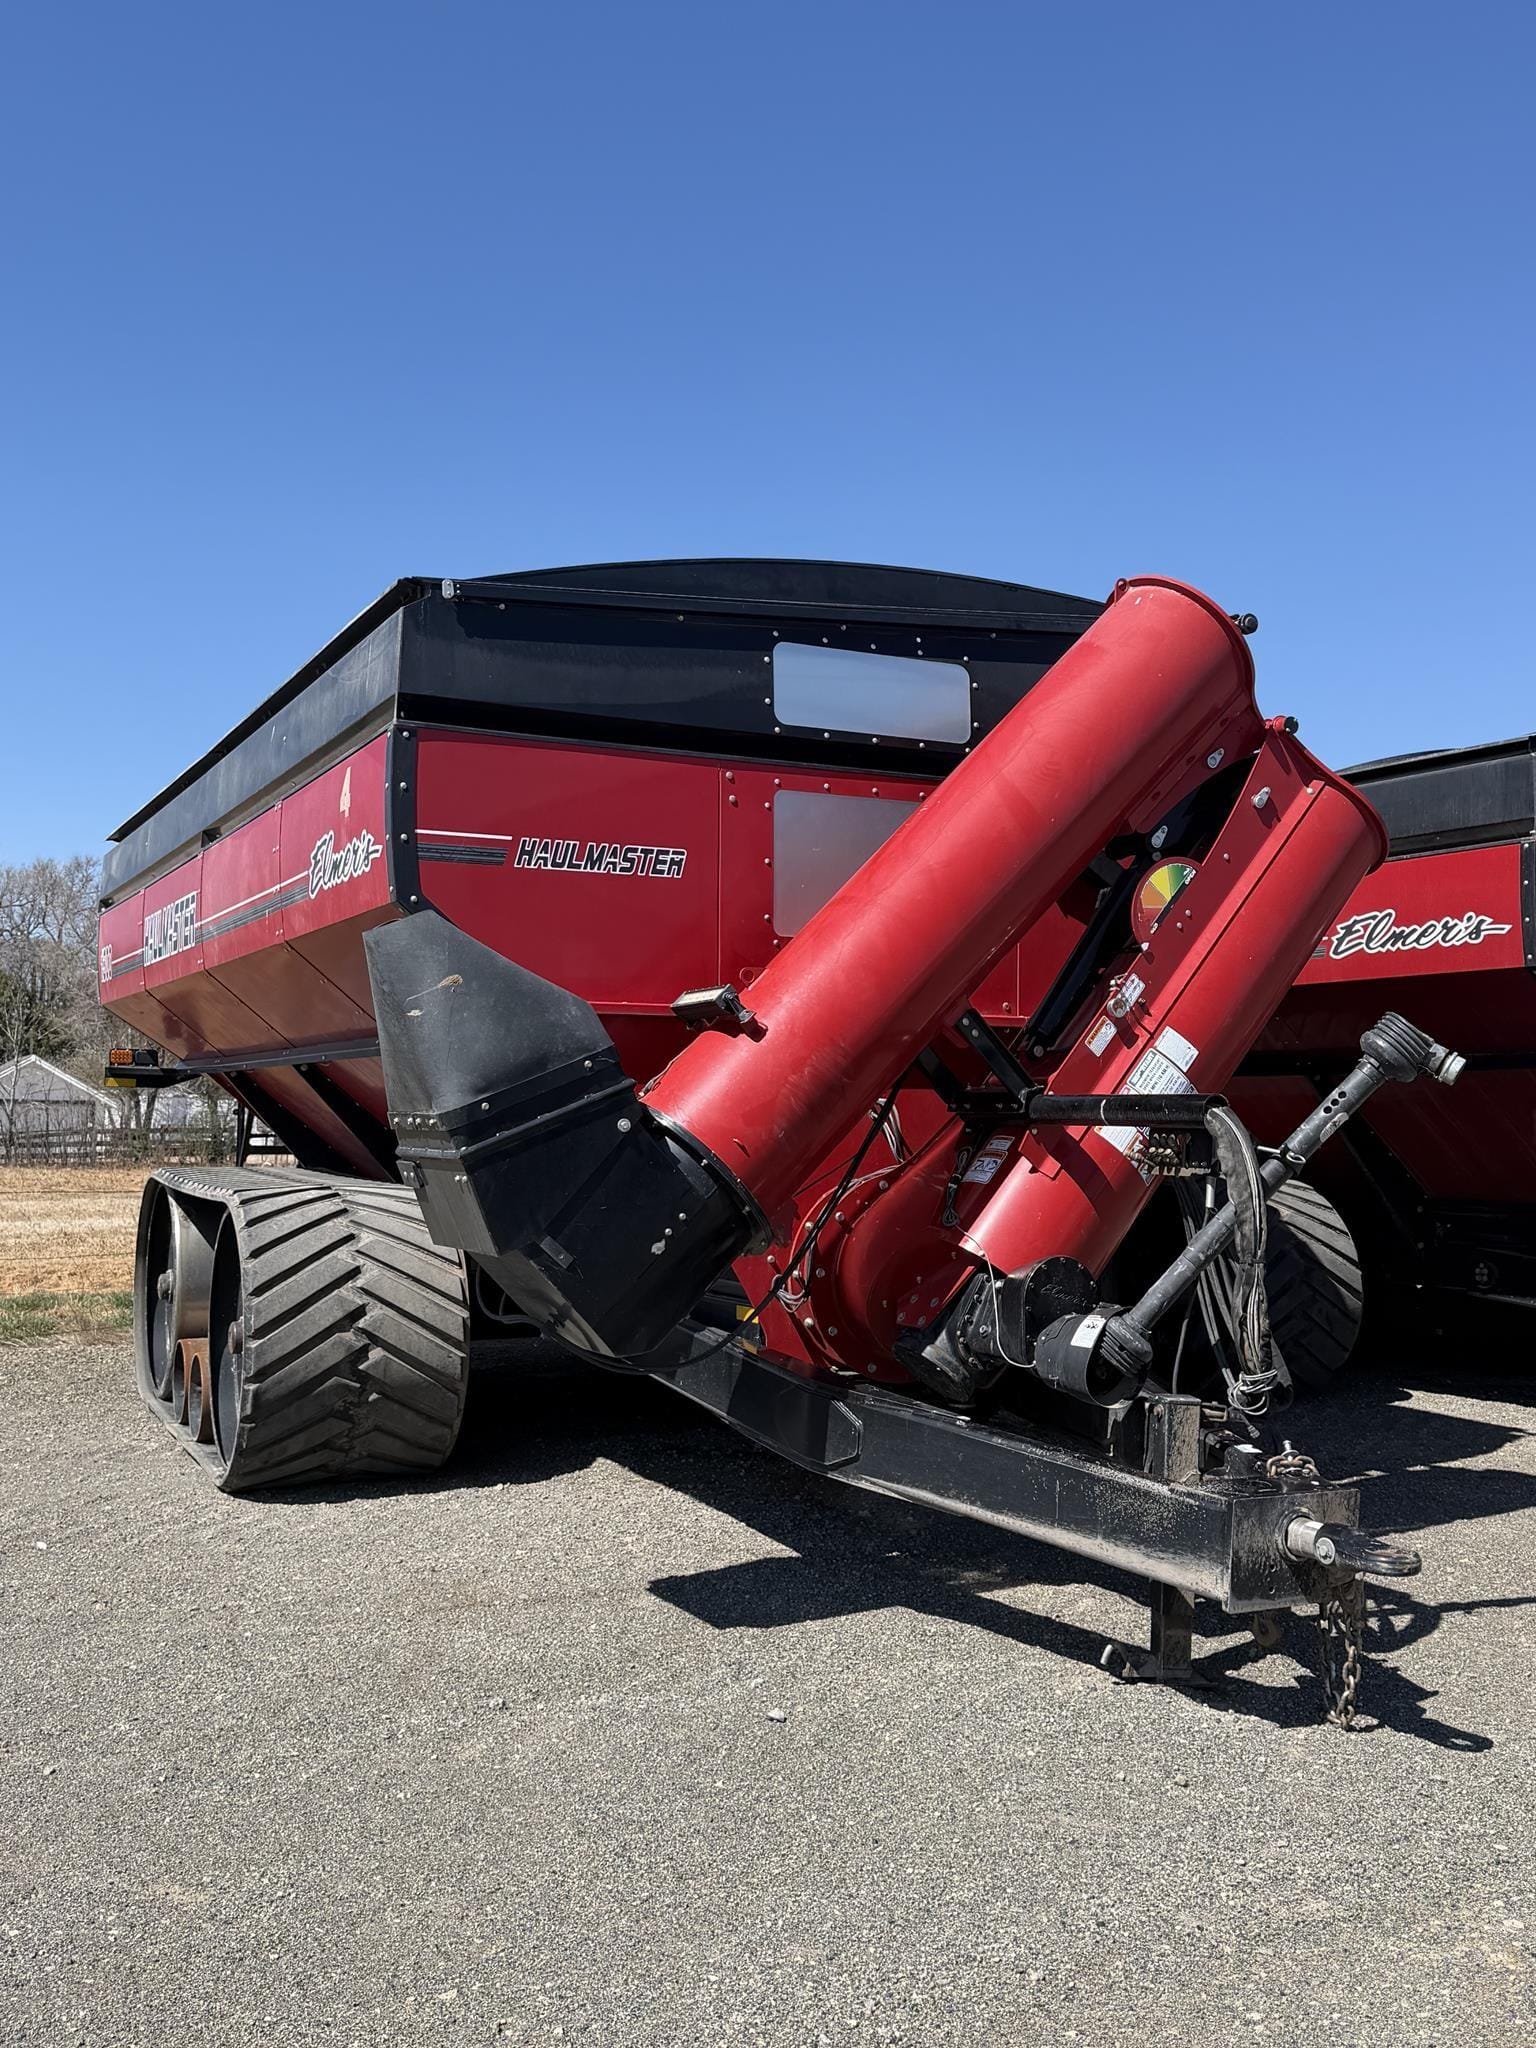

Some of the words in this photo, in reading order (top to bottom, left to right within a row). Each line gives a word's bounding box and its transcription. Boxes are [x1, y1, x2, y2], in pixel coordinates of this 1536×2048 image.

[340, 766, 351, 818] 4
[309, 829, 383, 899] Elmer's
[514, 837, 687, 878] HAULMASTER
[144, 891, 197, 967] HAULMASTER
[1329, 908, 1513, 960] Elmer's
